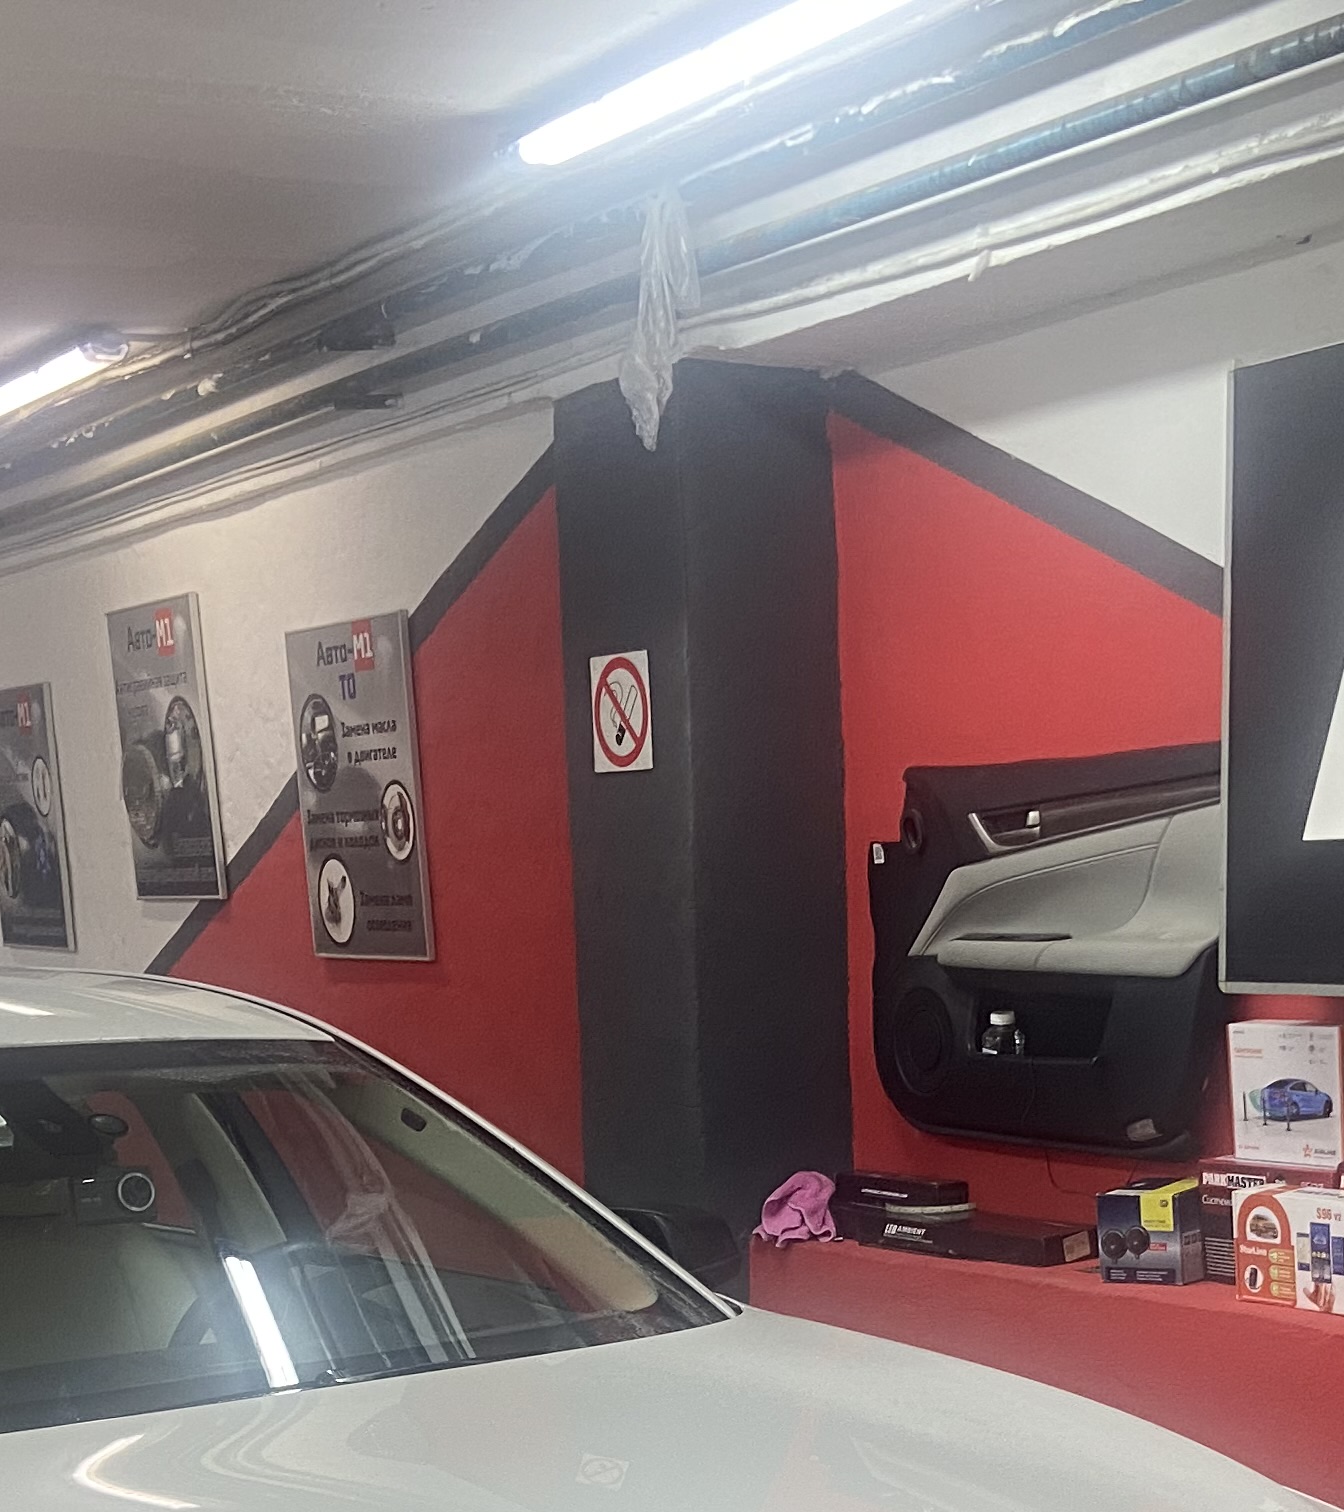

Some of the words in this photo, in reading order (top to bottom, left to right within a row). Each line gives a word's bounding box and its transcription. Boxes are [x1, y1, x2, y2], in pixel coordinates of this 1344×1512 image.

[316, 632, 374, 667] Авто-М1
[339, 672, 356, 701] ТО
[885, 1223, 897, 1235] LED
